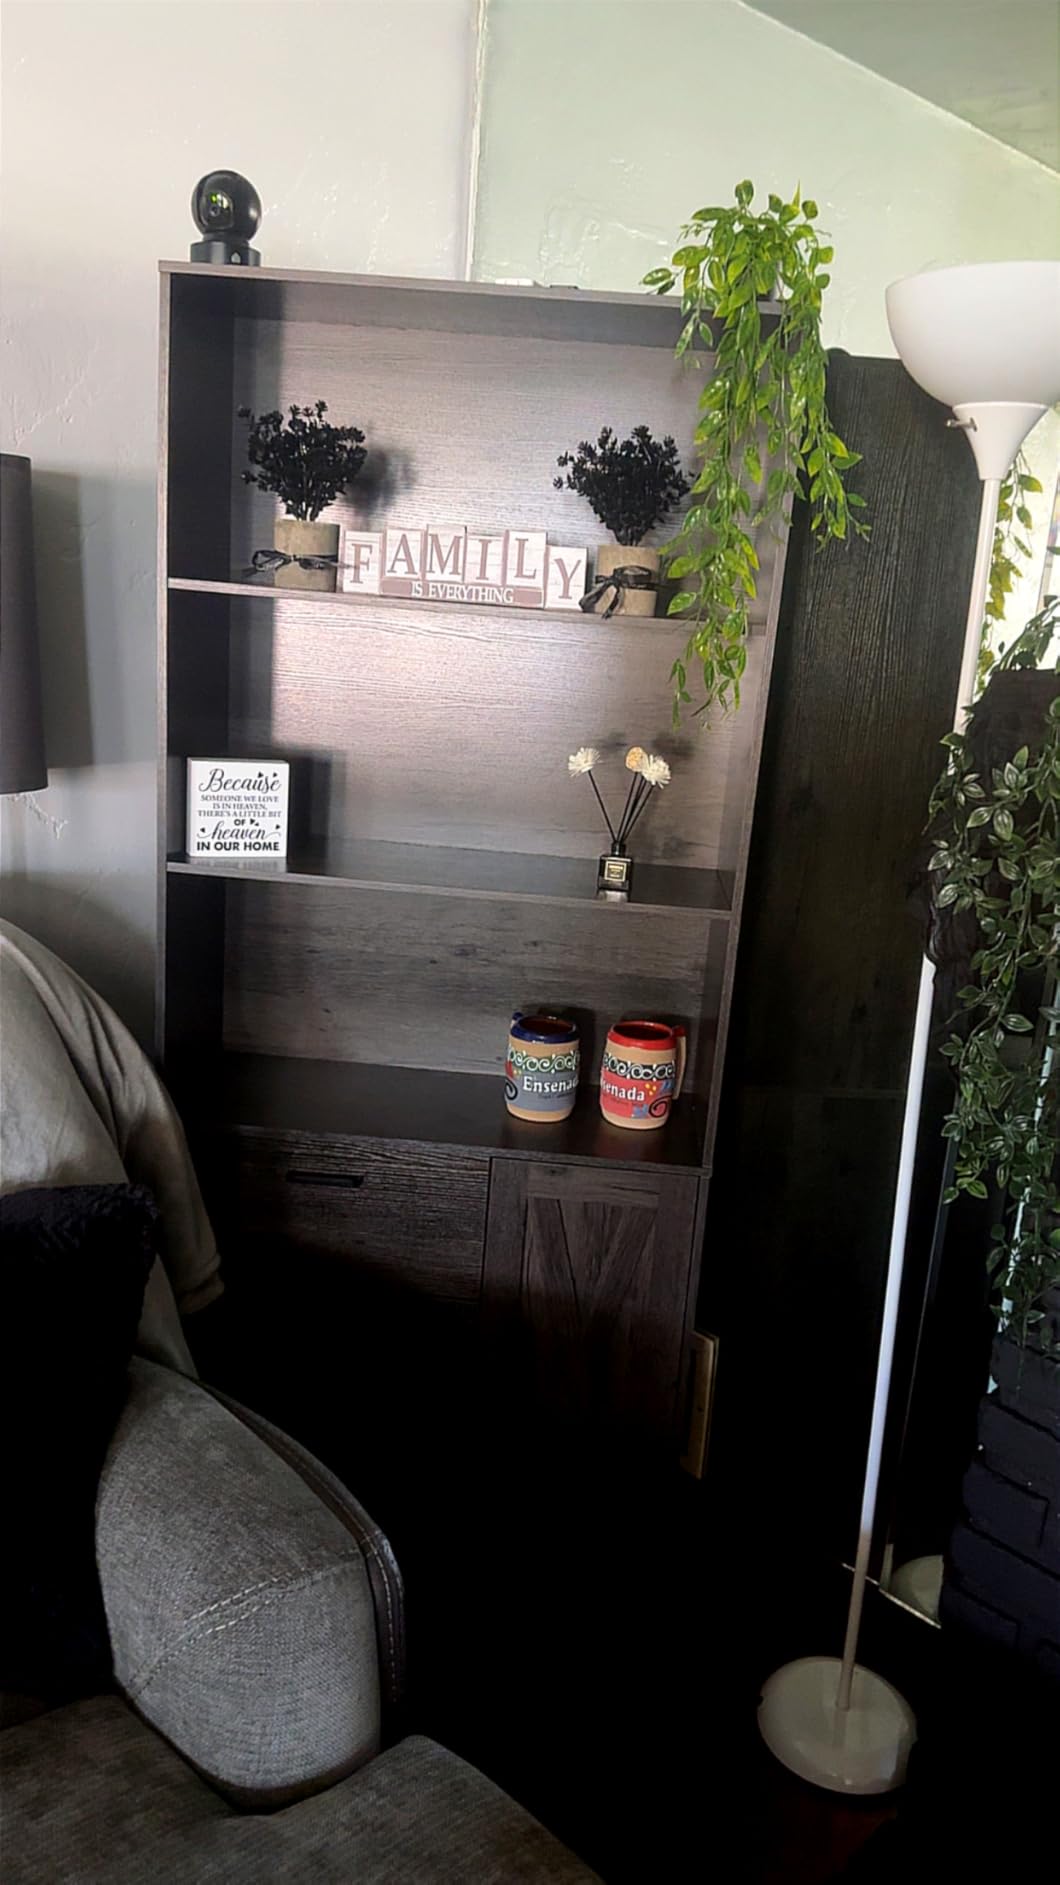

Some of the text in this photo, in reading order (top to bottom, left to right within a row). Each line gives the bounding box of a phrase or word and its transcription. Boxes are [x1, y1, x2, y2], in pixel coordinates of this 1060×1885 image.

[350, 533, 582, 600] FAMILY
[411, 581, 514, 603] IS EVERYTHING
[198, 768, 282, 794] Because
[200, 794, 242, 802] SOMEONE
[258, 795, 279, 803] LOVE
[222, 802, 232, 810] IN
[239, 810, 266, 818] LITTLE
[268, 810, 282, 818] BIT
[233, 818, 246, 826] OF
[211, 820, 266, 840] heaven
[196, 841, 280, 851] IN OUR HOME
